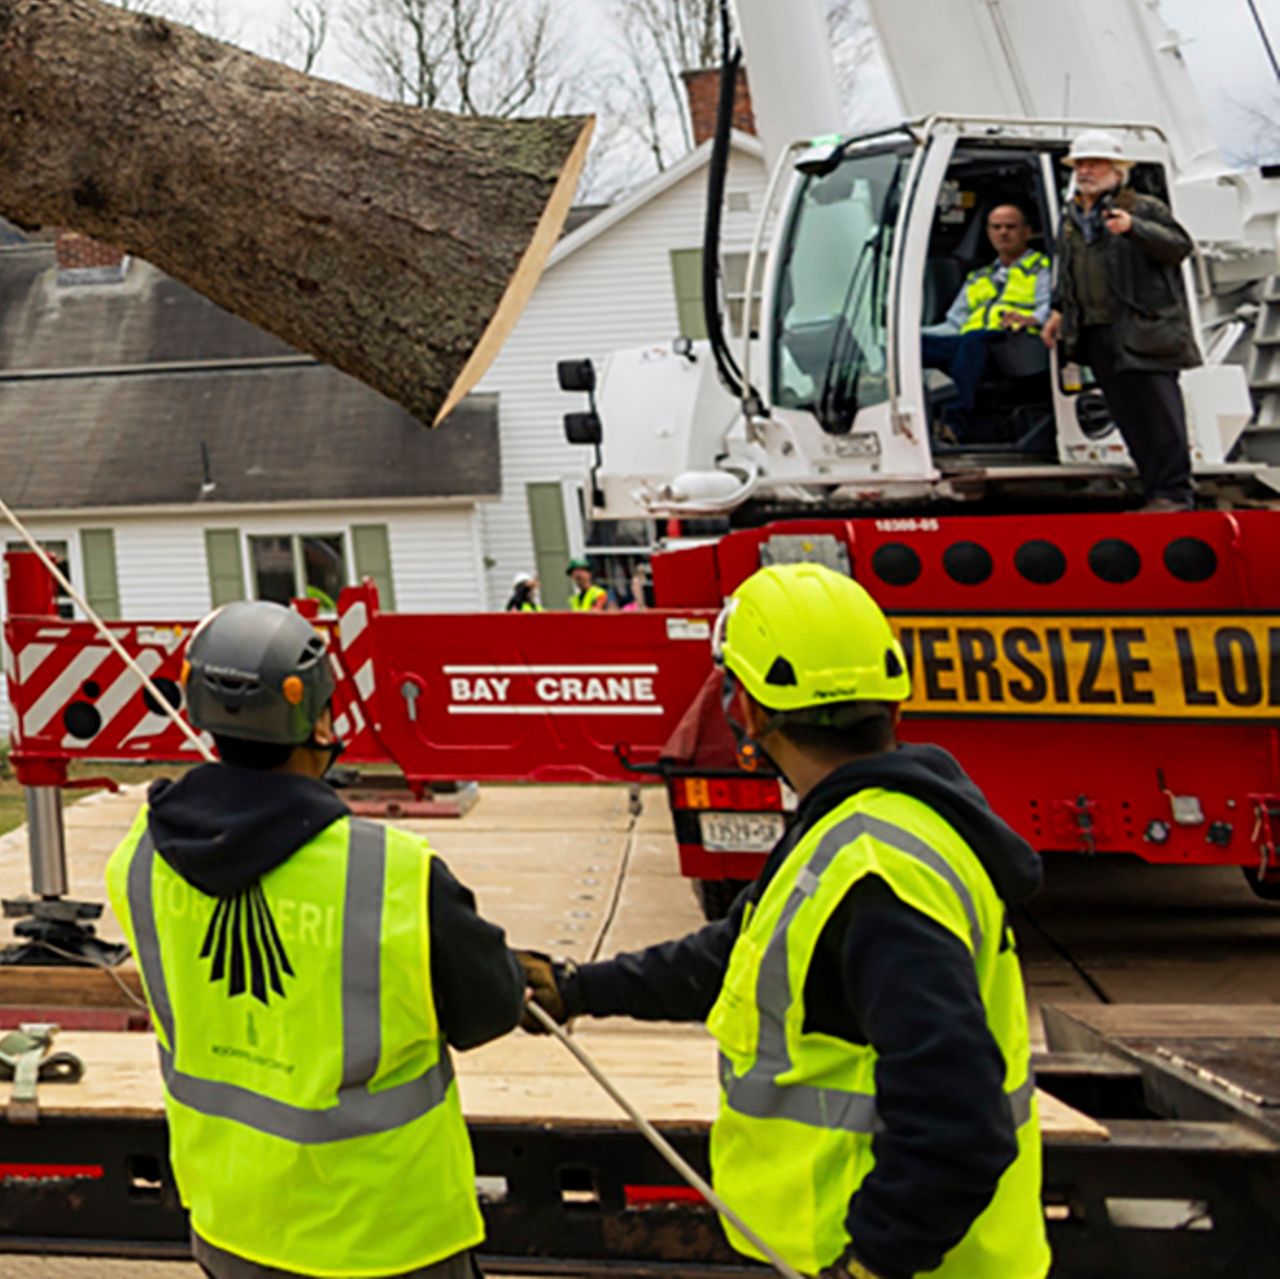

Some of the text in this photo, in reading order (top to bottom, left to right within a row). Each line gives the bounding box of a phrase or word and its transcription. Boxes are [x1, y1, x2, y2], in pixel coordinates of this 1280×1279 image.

[450, 677, 657, 702] BAY CRANE
[900, 627, 1280, 708] ERSIZE LO
